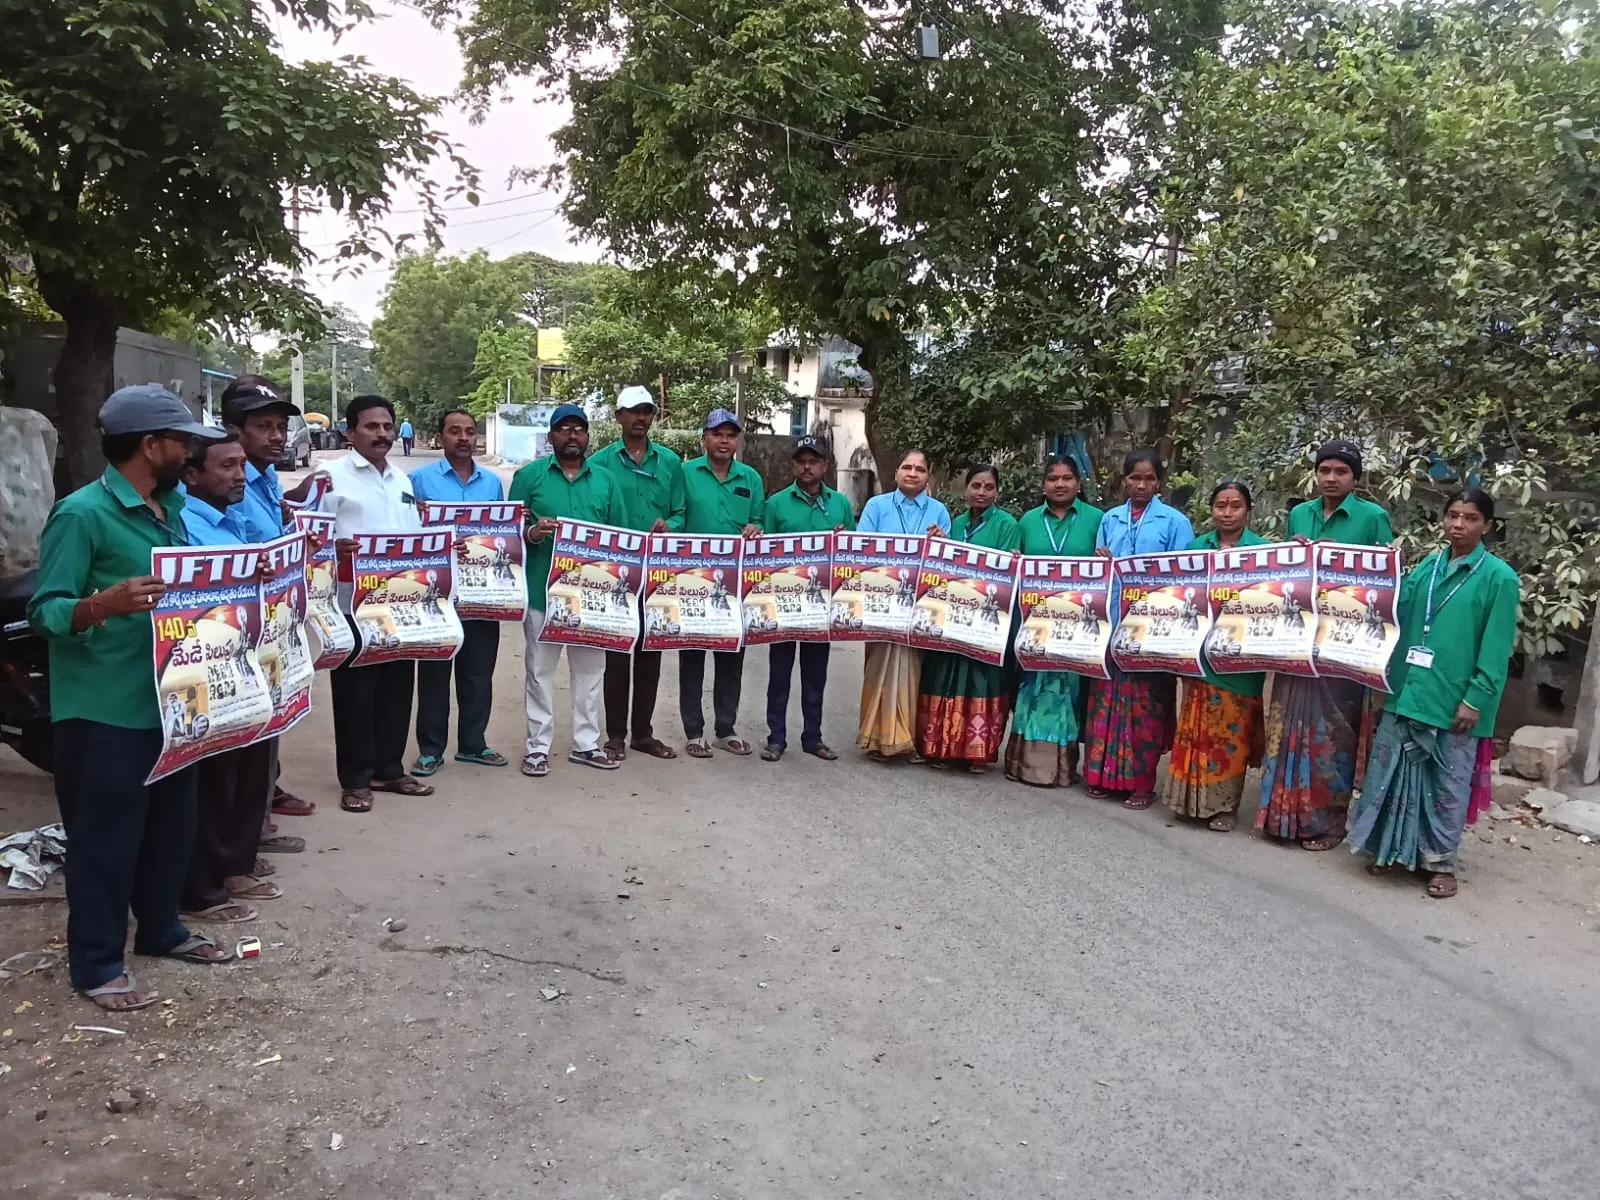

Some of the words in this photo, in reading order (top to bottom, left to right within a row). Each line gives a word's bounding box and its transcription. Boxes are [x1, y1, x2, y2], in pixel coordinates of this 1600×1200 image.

[797, 437, 817, 448] BOY
[428, 506, 515, 522] IFTU
[302, 518, 336, 540] IFT
[561, 522, 642, 551] IFTU
[358, 534, 446, 555] IFTU
[652, 538, 734, 554] IFTU
[746, 536, 825, 555] IFTU
[838, 536, 919, 553] IFTU
[268, 539, 303, 570] FTU
[928, 541, 1011, 570] IFTU
[1214, 547, 1305, 570] IFTU
[1321, 548, 1388, 571] FTU
[161, 553, 259, 584] IFTU
[554, 557, 574, 570] 140
[1025, 560, 1104, 578] IFTU
[1118, 555, 1205, 573] IFTU
[649, 569, 667, 582] 140
[743, 570, 762, 583] 140
[833, 567, 852, 578] 140
[920, 572, 939, 588] 140
[357, 575, 378, 590] 140
[559, 571, 581, 586] మేడే
[581, 577, 612, 592] పిలుపు
[752, 583, 771, 594] మేడే
[774, 584, 804, 594] పిలుపు
[842, 580, 862, 591] మేడే
[864, 584, 894, 595] పిలుపు
[364, 590, 386, 605] మేడే
[389, 591, 421, 605] పిలుపు
[655, 583, 677, 595] మేడే
[679, 586, 708, 598] పిలుపు
[927, 588, 948, 601] మేడే
[950, 594, 980, 609] పిలుపు
[1022, 592, 1038, 605] 140
[1122, 588, 1139, 601] 140
[1210, 587, 1230, 601] 140
[1031, 606, 1049, 619] మేడే
[1052, 609, 1080, 622] పిలుపు
[1129, 602, 1148, 616] మేడే
[1150, 606, 1179, 619] పిలుపు
[1221, 601, 1244, 615] మేడే
[1245, 603, 1280, 616] పిలుపు
[1331, 608, 1364, 623] పిలుపు
[157, 617, 184, 641] 140
[172, 639, 202, 667] మేడే
[205, 639, 235, 661] పిలుపు
